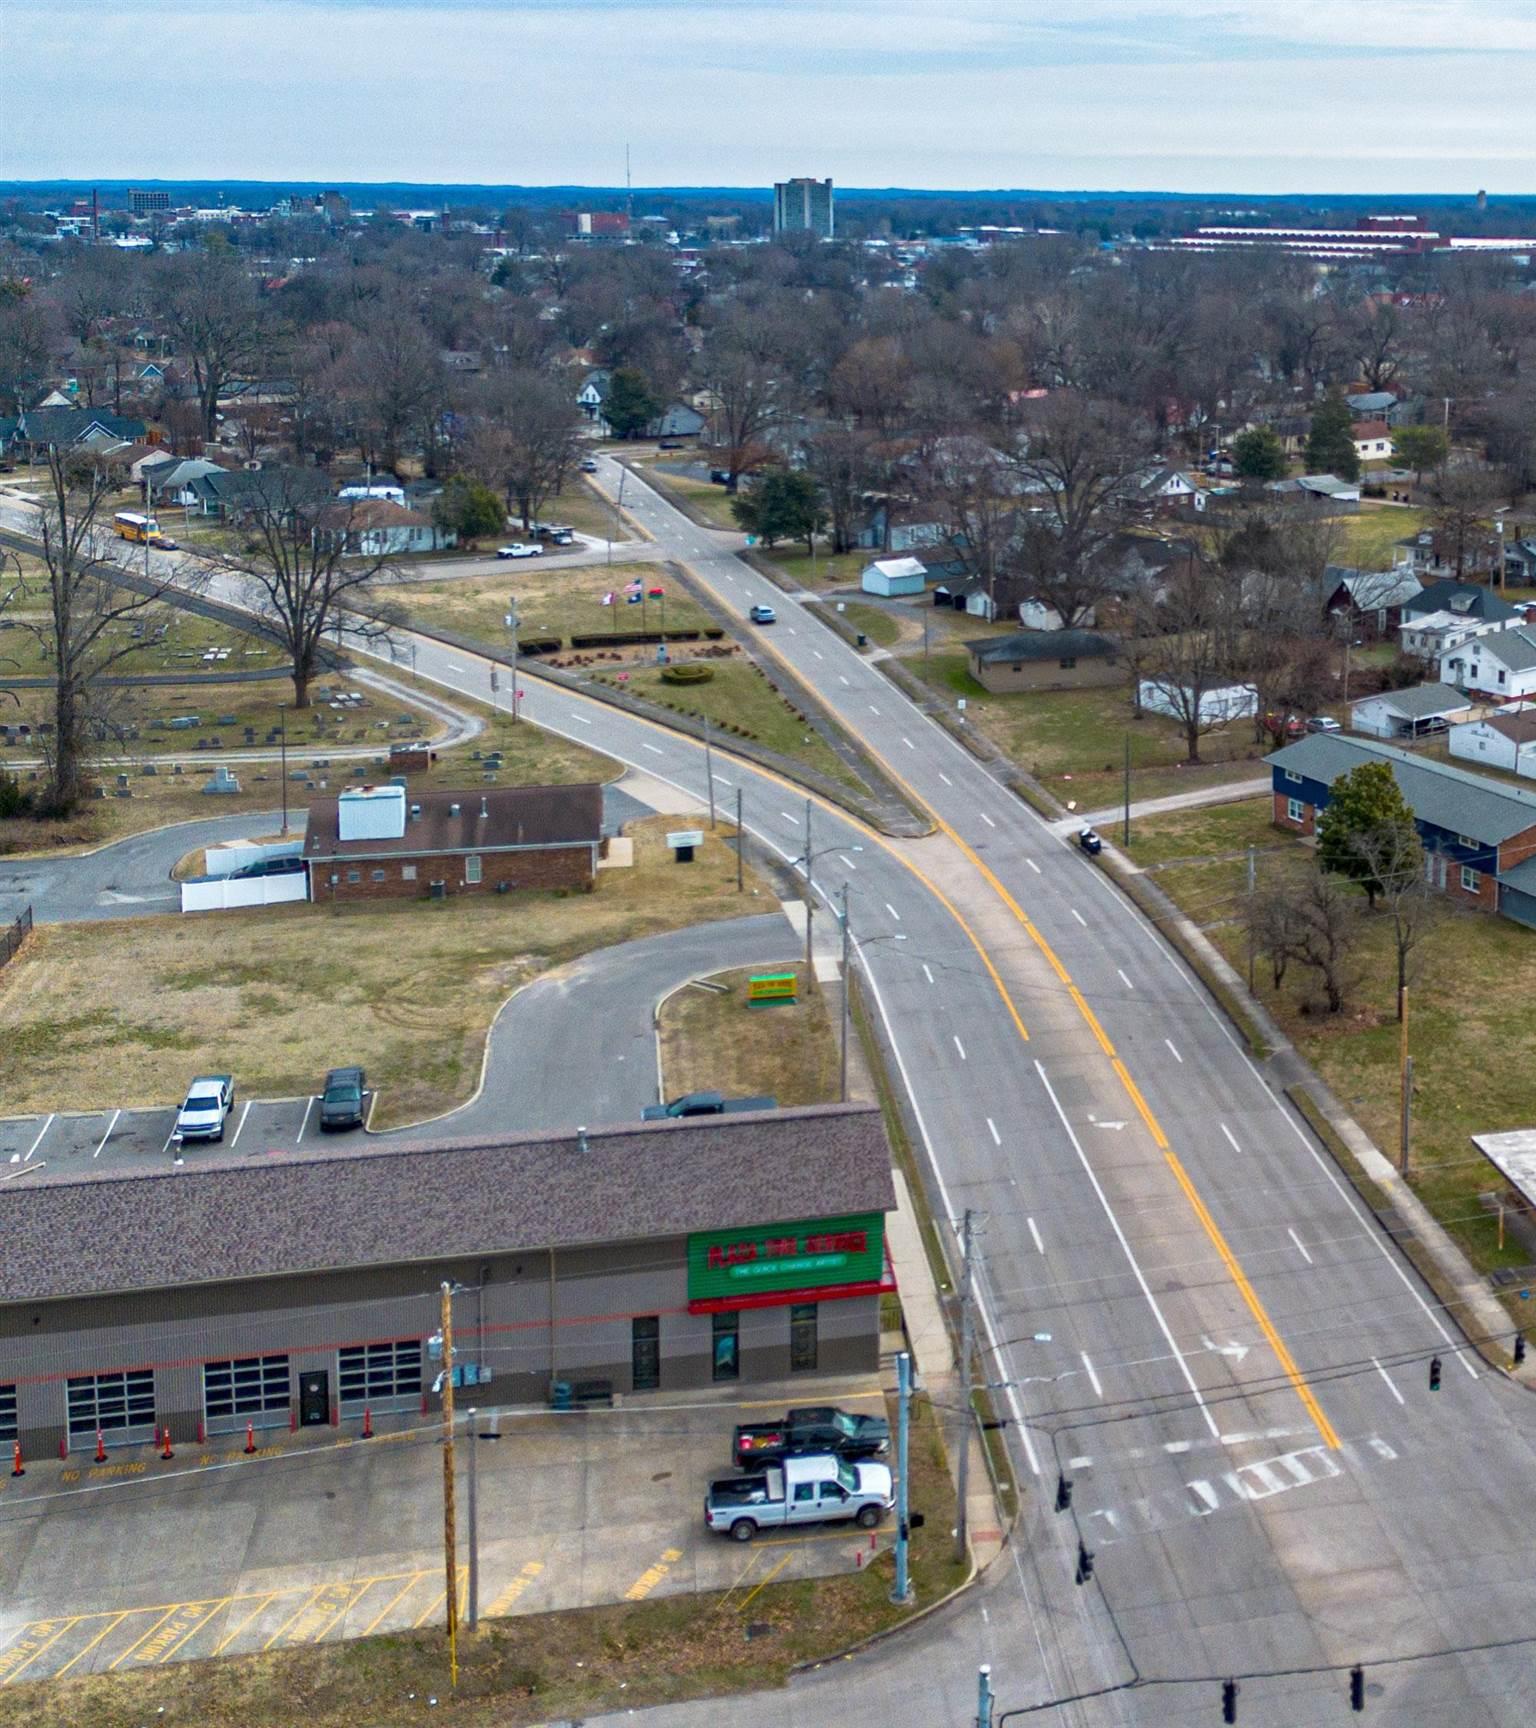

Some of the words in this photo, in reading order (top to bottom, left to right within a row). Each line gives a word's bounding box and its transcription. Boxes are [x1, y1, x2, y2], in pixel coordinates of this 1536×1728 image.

[708, 1242, 757, 1269] PLAZA
[765, 1237, 797, 1257] TIRE
[63, 1470, 80, 1482] NO
[88, 1462, 147, 1480] PARKING
[660, 1548, 683, 1562] NO
[521, 1561, 544, 1575] NO
[625, 1563, 669, 1601] PARKING
[484, 1577, 531, 1616] PARKING
[182, 1604, 207, 1618] NO
[30, 1623, 56, 1637] NO
[134, 1621, 188, 1661] PARKING
